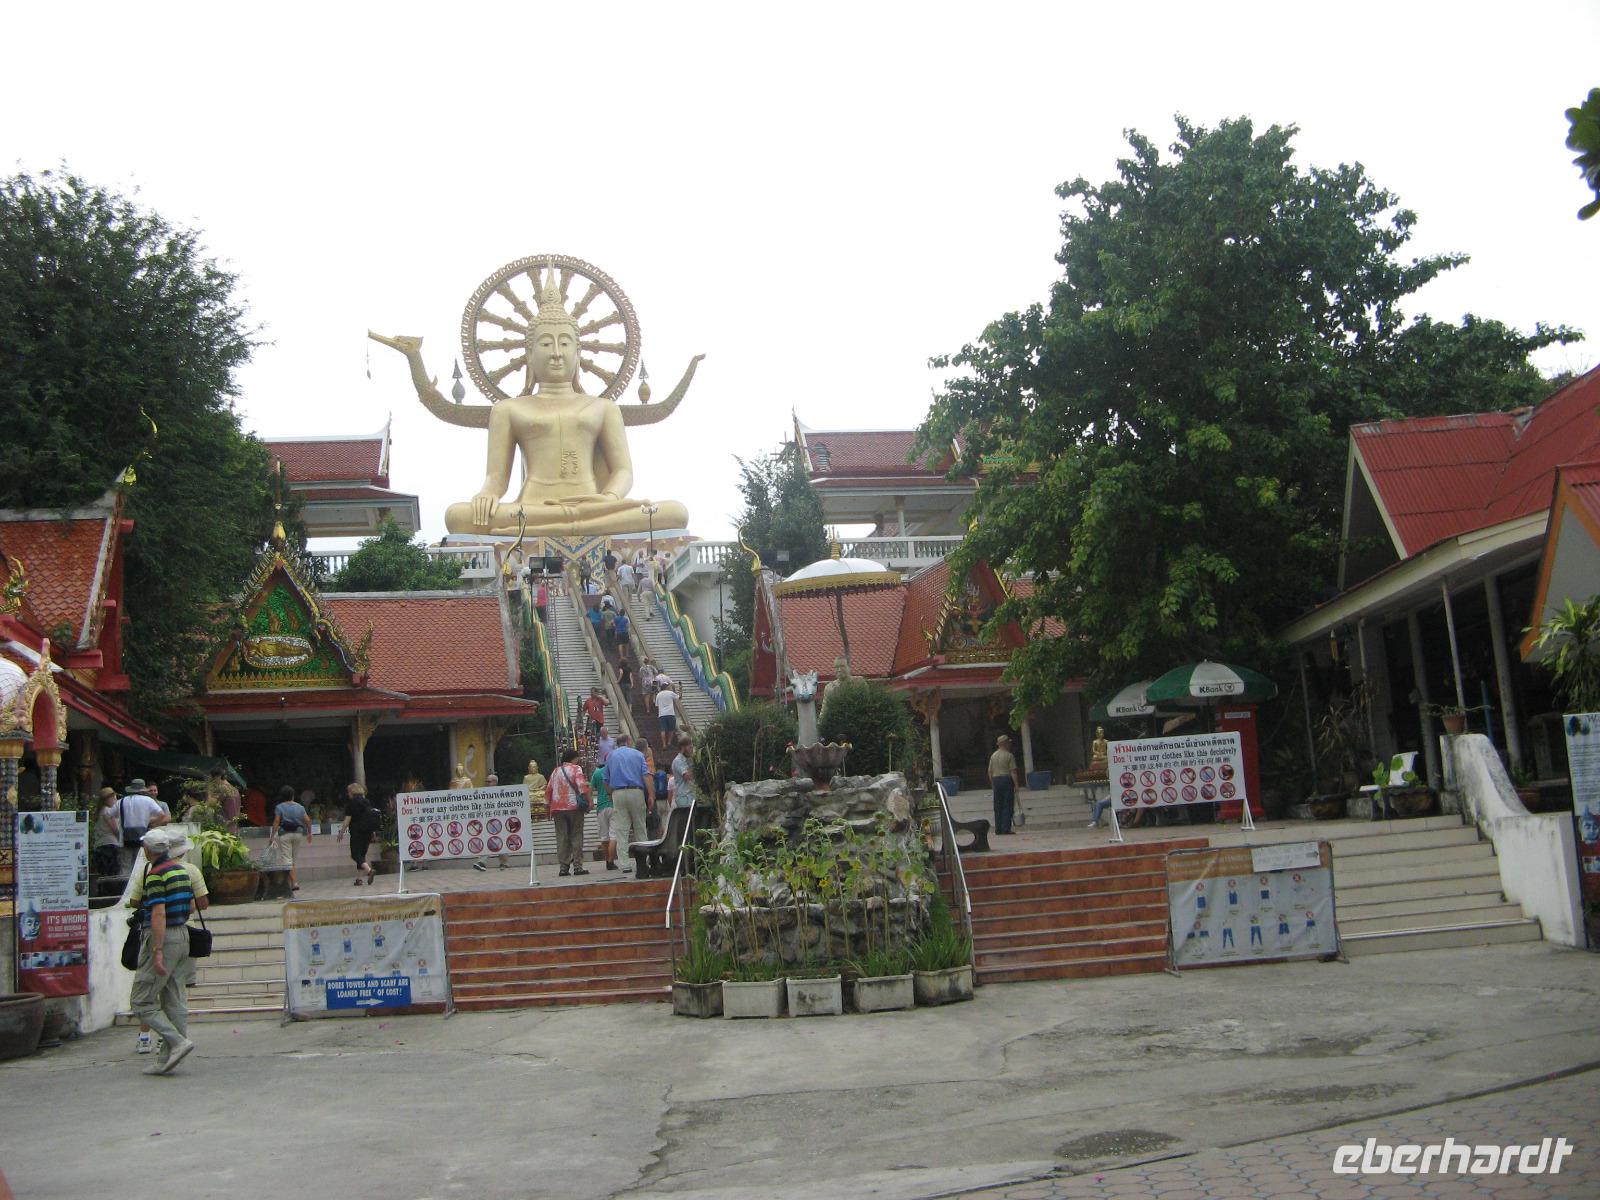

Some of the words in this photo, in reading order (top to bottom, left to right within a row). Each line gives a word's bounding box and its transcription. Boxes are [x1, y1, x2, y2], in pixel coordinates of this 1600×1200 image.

[1161, 751, 1182, 760] clothes
[1183, 750, 1195, 758] like
[1196, 749, 1208, 757] this
[1209, 747, 1237, 757] decisively
[422, 806, 435, 814] wear
[436, 806, 448, 815] any
[449, 803, 470, 812] clothes
[471, 802, 482, 811] like
[484, 801, 495, 809] this
[496, 799, 525, 809] decisively
[61, 913, 87, 924] WRONG
[367, 980, 379, 988] AND
[397, 978, 409, 986] ARE
[336, 990, 358, 998] LOANED
[359, 989, 372, 997] FREE
[377, 988, 385, 997] OF
